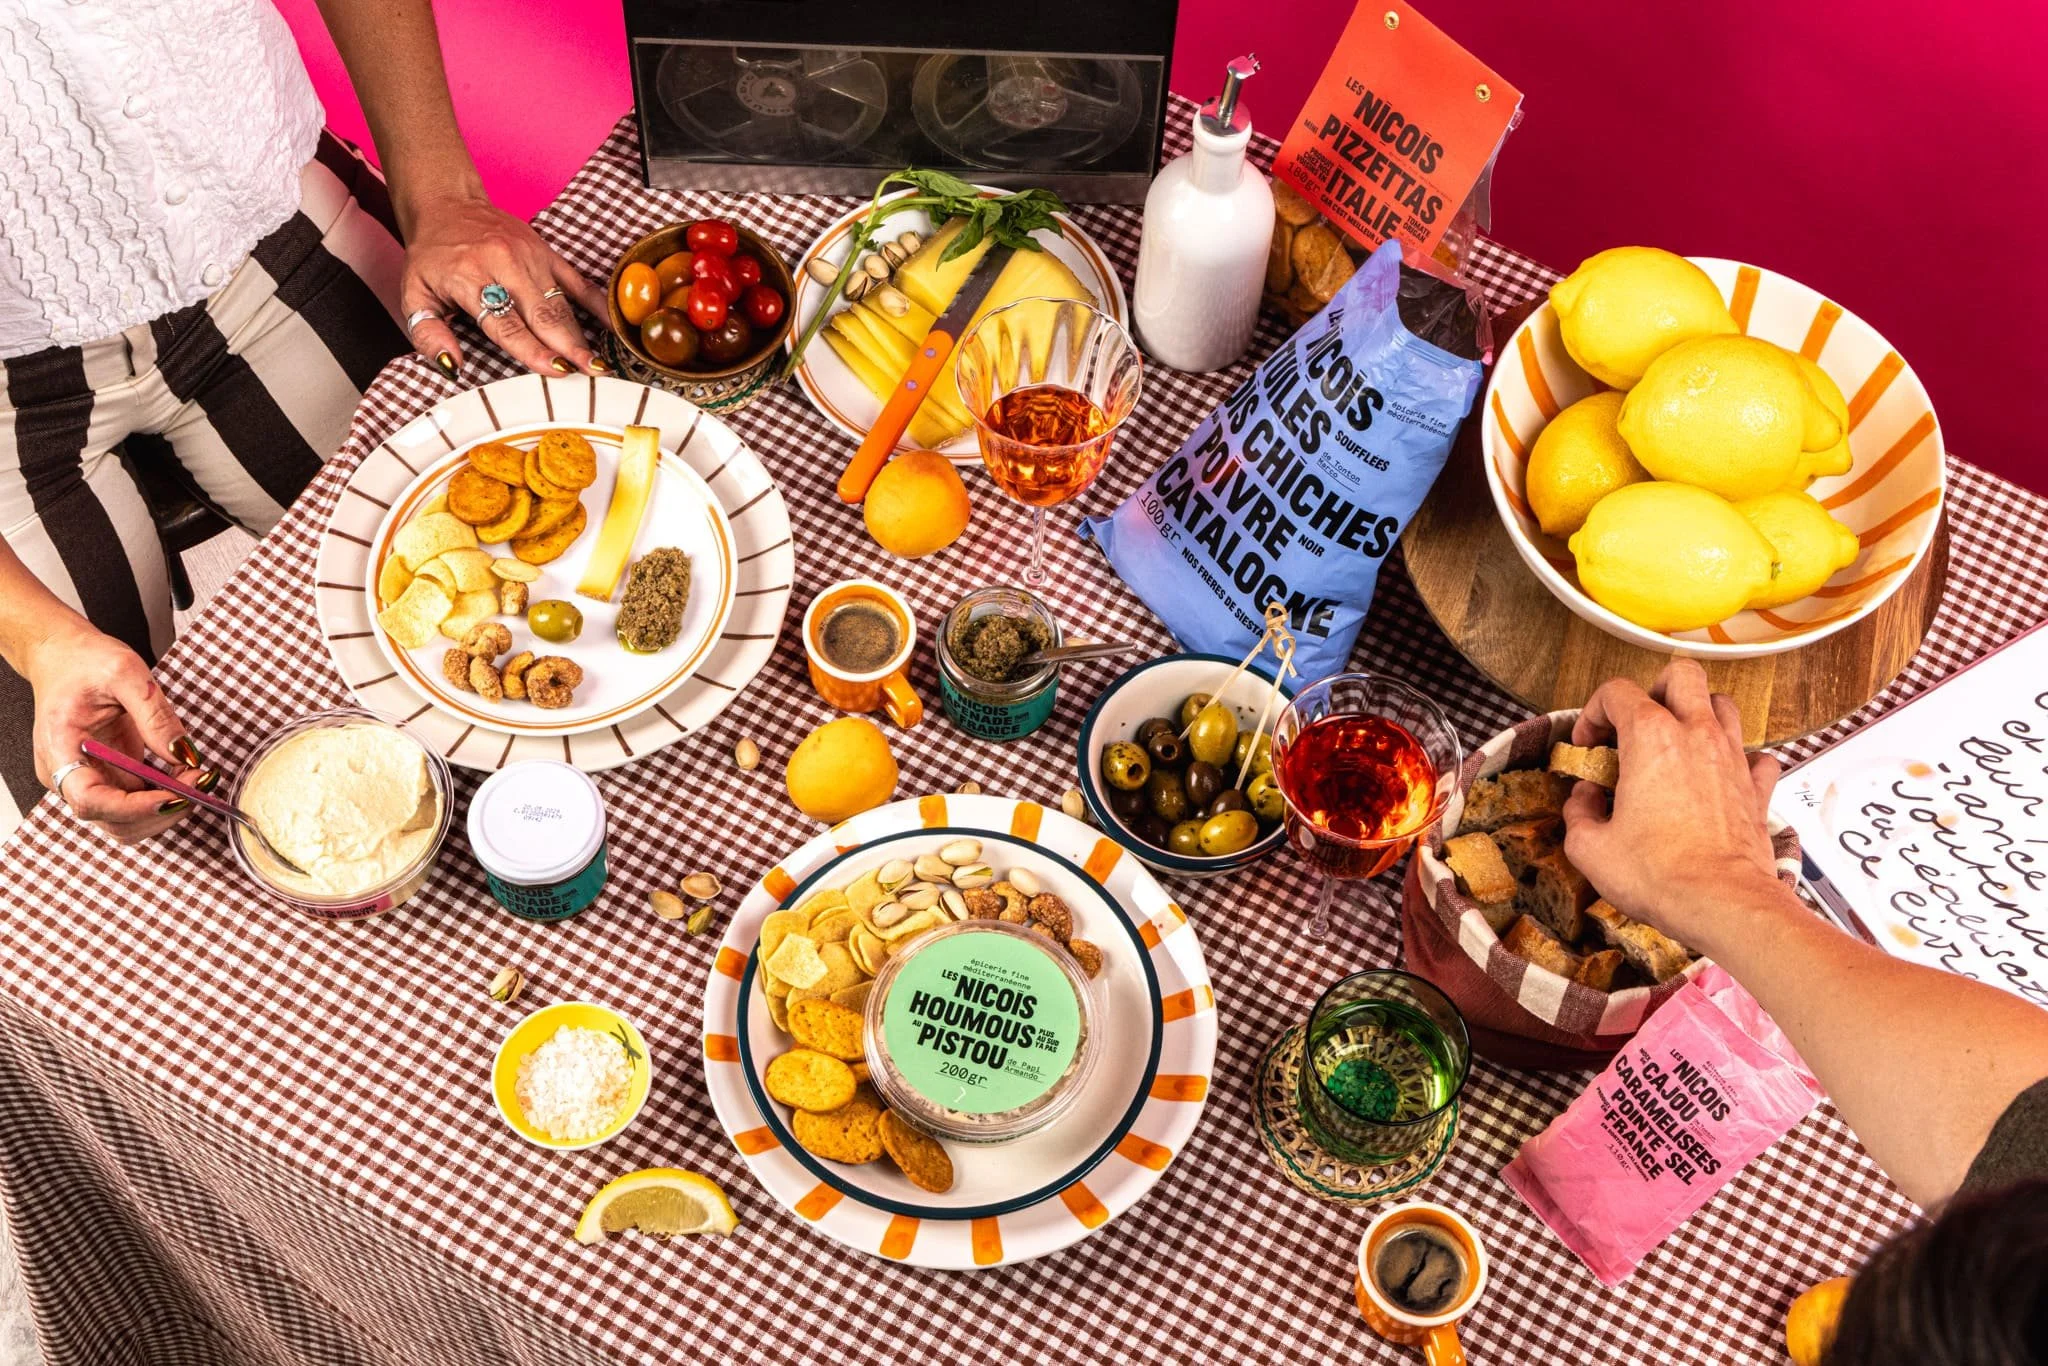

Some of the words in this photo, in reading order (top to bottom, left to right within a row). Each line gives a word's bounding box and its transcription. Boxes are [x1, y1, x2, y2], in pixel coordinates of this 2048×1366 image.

[1345, 76, 1365, 96] LES
[1318, 113, 1443, 225] PIZZETTAS
[1407, 215, 1431, 238] TOMATE
[1428, 413, 1447, 430] fine
[1317, 458, 1340, 480] Marco
[1321, 450, 1333, 463] de
[1333, 458, 1362, 484] Tonton
[1194, 422, 1298, 561] POIVRE
[1298, 533, 1326, 558] NOIR
[1242, 418, 1400, 559] CHICHES
[1155, 456, 1343, 639] CATALOGNE
[1141, 490, 1183, 543] 100gr
[1181, 546, 1199, 569] NOS
[1224, 595, 1237, 612] DE
[1234, 607, 1265, 639] SIESTA
[959, 715, 1021, 735] FRANCE
[1959, 735, 2044, 817] leur
[1899, 843, 2048, 1006] réalisat
[941, 968, 959, 982] LES
[963, 964, 1032, 990] méditerranéenne
[970, 958, 1008, 975] épicerie
[1011, 969, 1031, 982] fine
[908, 990, 1037, 1049] HOUMOUS
[911, 1019, 922, 1028] AU
[916, 1022, 1009, 1070] PISTOU
[1036, 1034, 1048, 1044] AU
[1046, 1038, 1060, 1048] SUD
[1038, 1028, 1056, 1039] PLUS
[1044, 1043, 1058, 1054] PAS
[1669, 1048, 1684, 1062] LES
[939, 1061, 988, 1086] 200gr
[1004, 1065, 1039, 1081] Armando
[1007, 1057, 1017, 1067] de
[1021, 1060, 1041, 1074] Papi
[1642, 1062, 1700, 1122] CAJOU
[1604, 1109, 1665, 1181] FRANCE
[1611, 1088, 1666, 1153] POINTE
[1664, 1151, 1698, 1186] SEL
